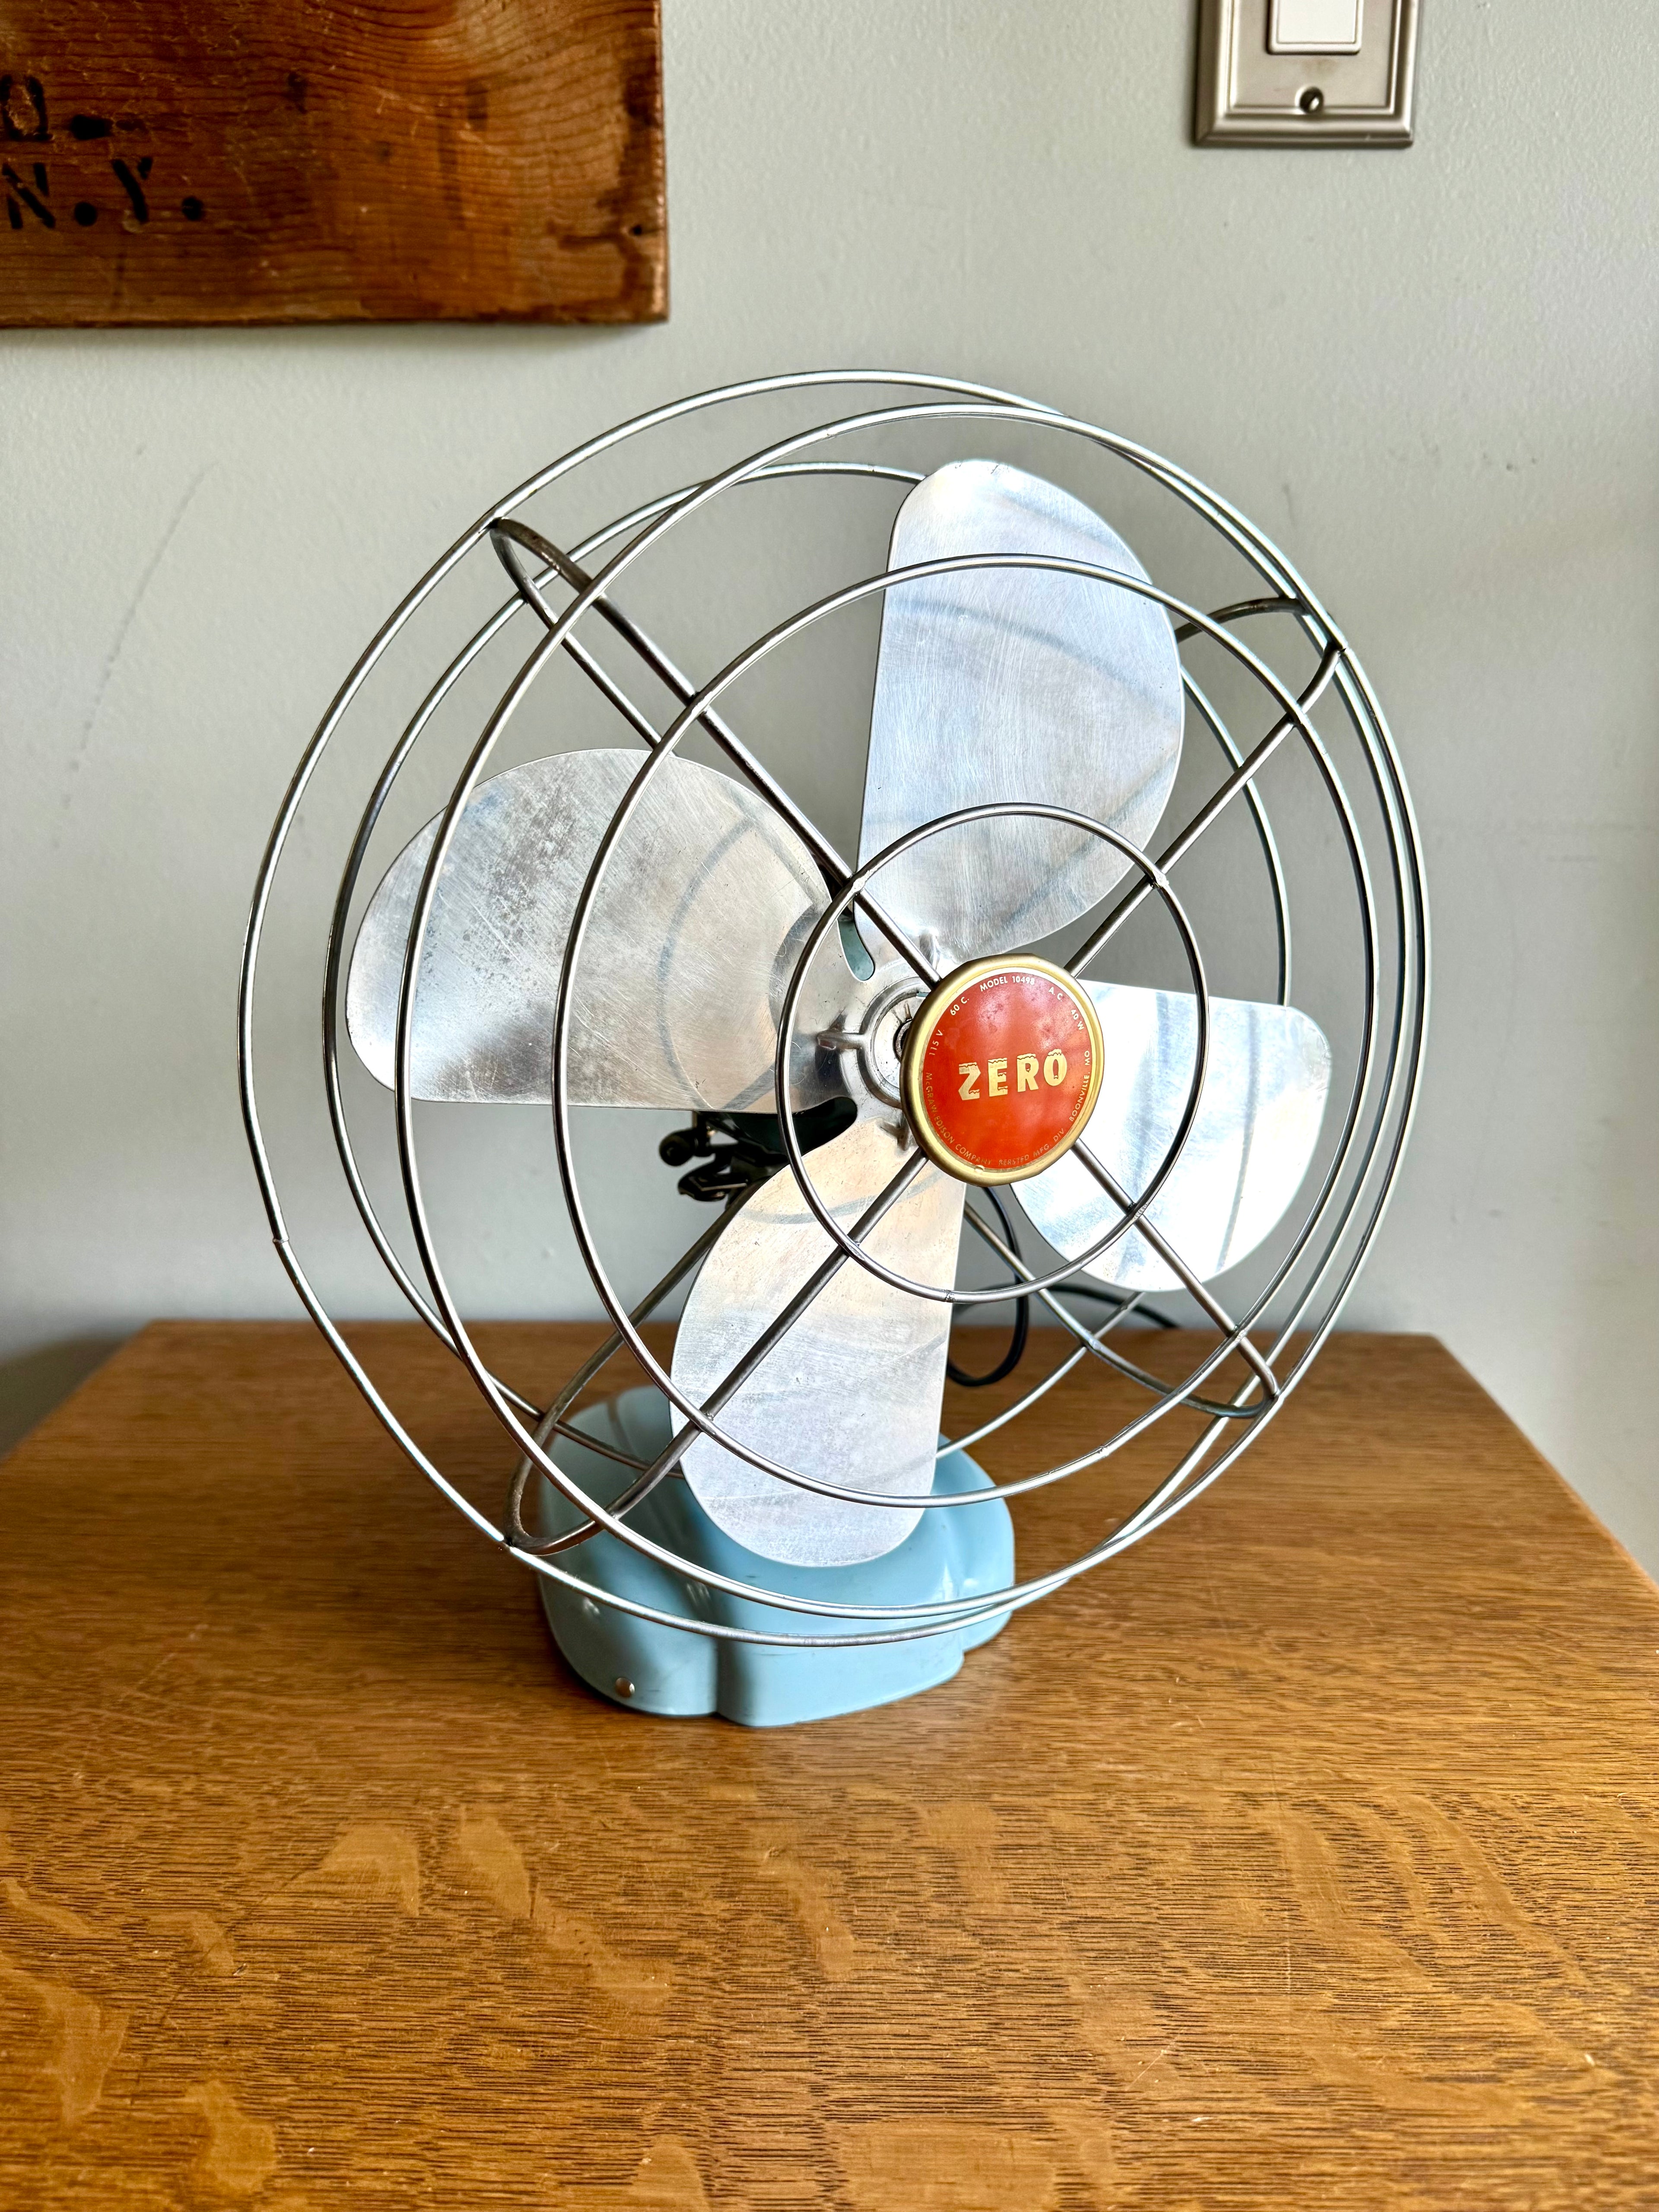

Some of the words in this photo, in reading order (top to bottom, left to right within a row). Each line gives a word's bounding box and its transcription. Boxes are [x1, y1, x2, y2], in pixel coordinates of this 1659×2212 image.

[929, 1040, 939, 1055] 115
[950, 1004, 960, 1016] 60
[961, 996, 969, 1004] C.
[979, 976, 1008, 992] MODEL
[1012, 976, 1035, 985] 10498
[1071, 1009, 1079, 1020] 40
[958, 1049, 1068, 1101] ZERO
[1069, 1071, 1090, 1122] BOONVILLE,
